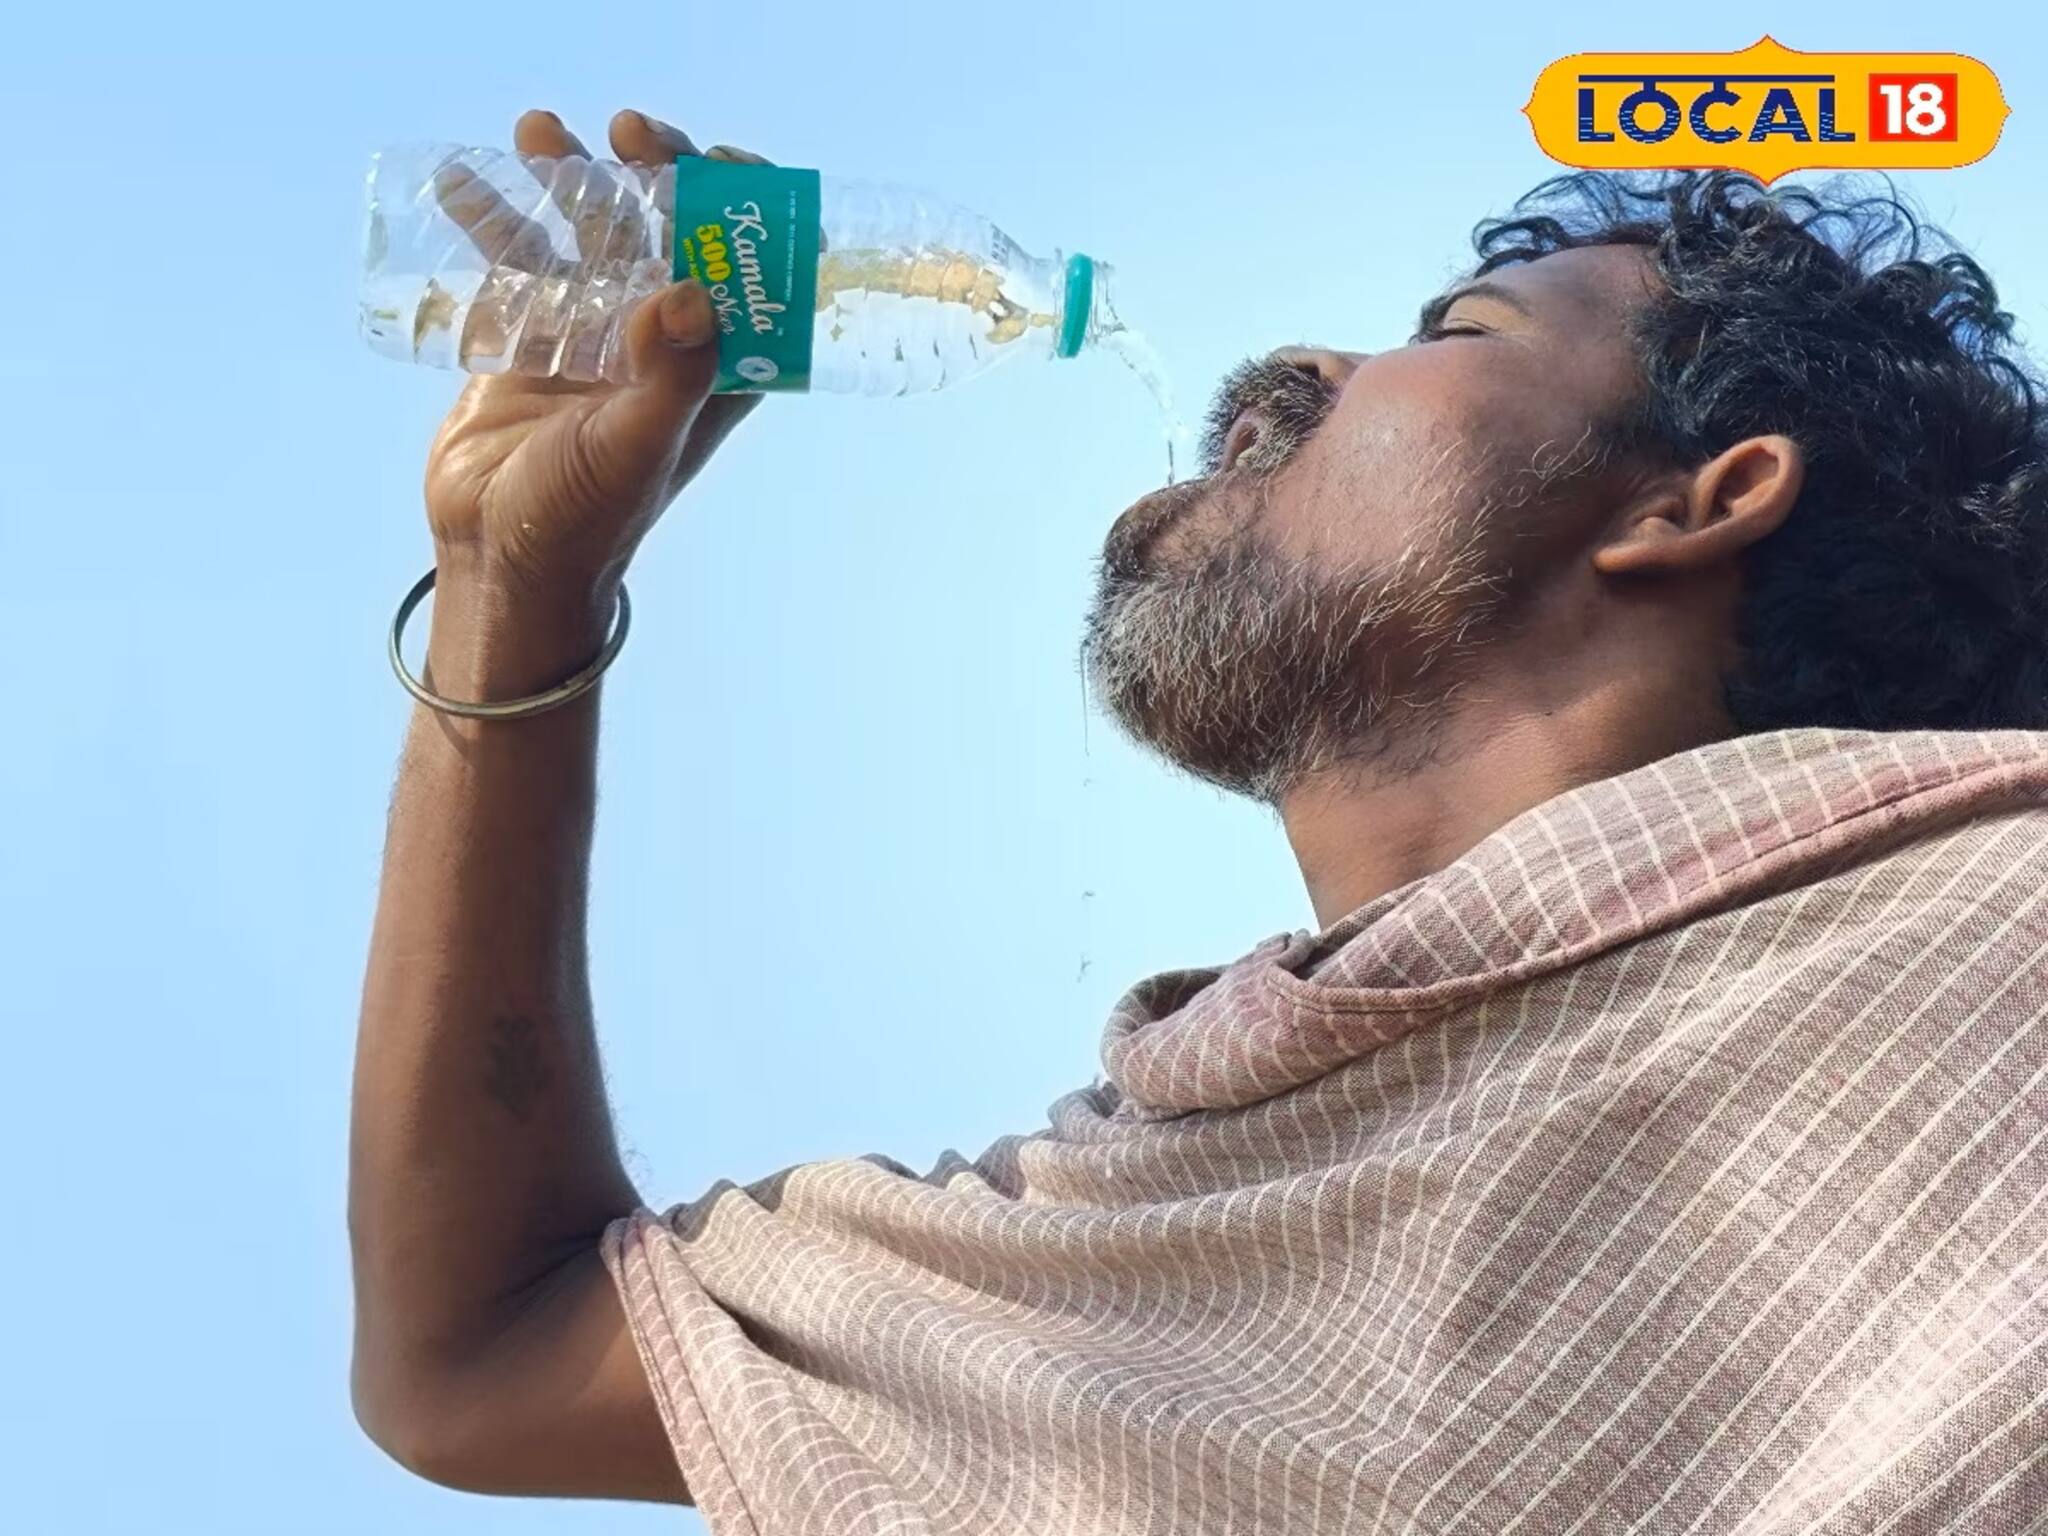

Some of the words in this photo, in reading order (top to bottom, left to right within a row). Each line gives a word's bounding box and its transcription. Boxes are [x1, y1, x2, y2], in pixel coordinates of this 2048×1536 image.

[696, 224, 731, 281] 500
[724, 201, 786, 335] Kamala
[710, 284, 742, 335] Neer
